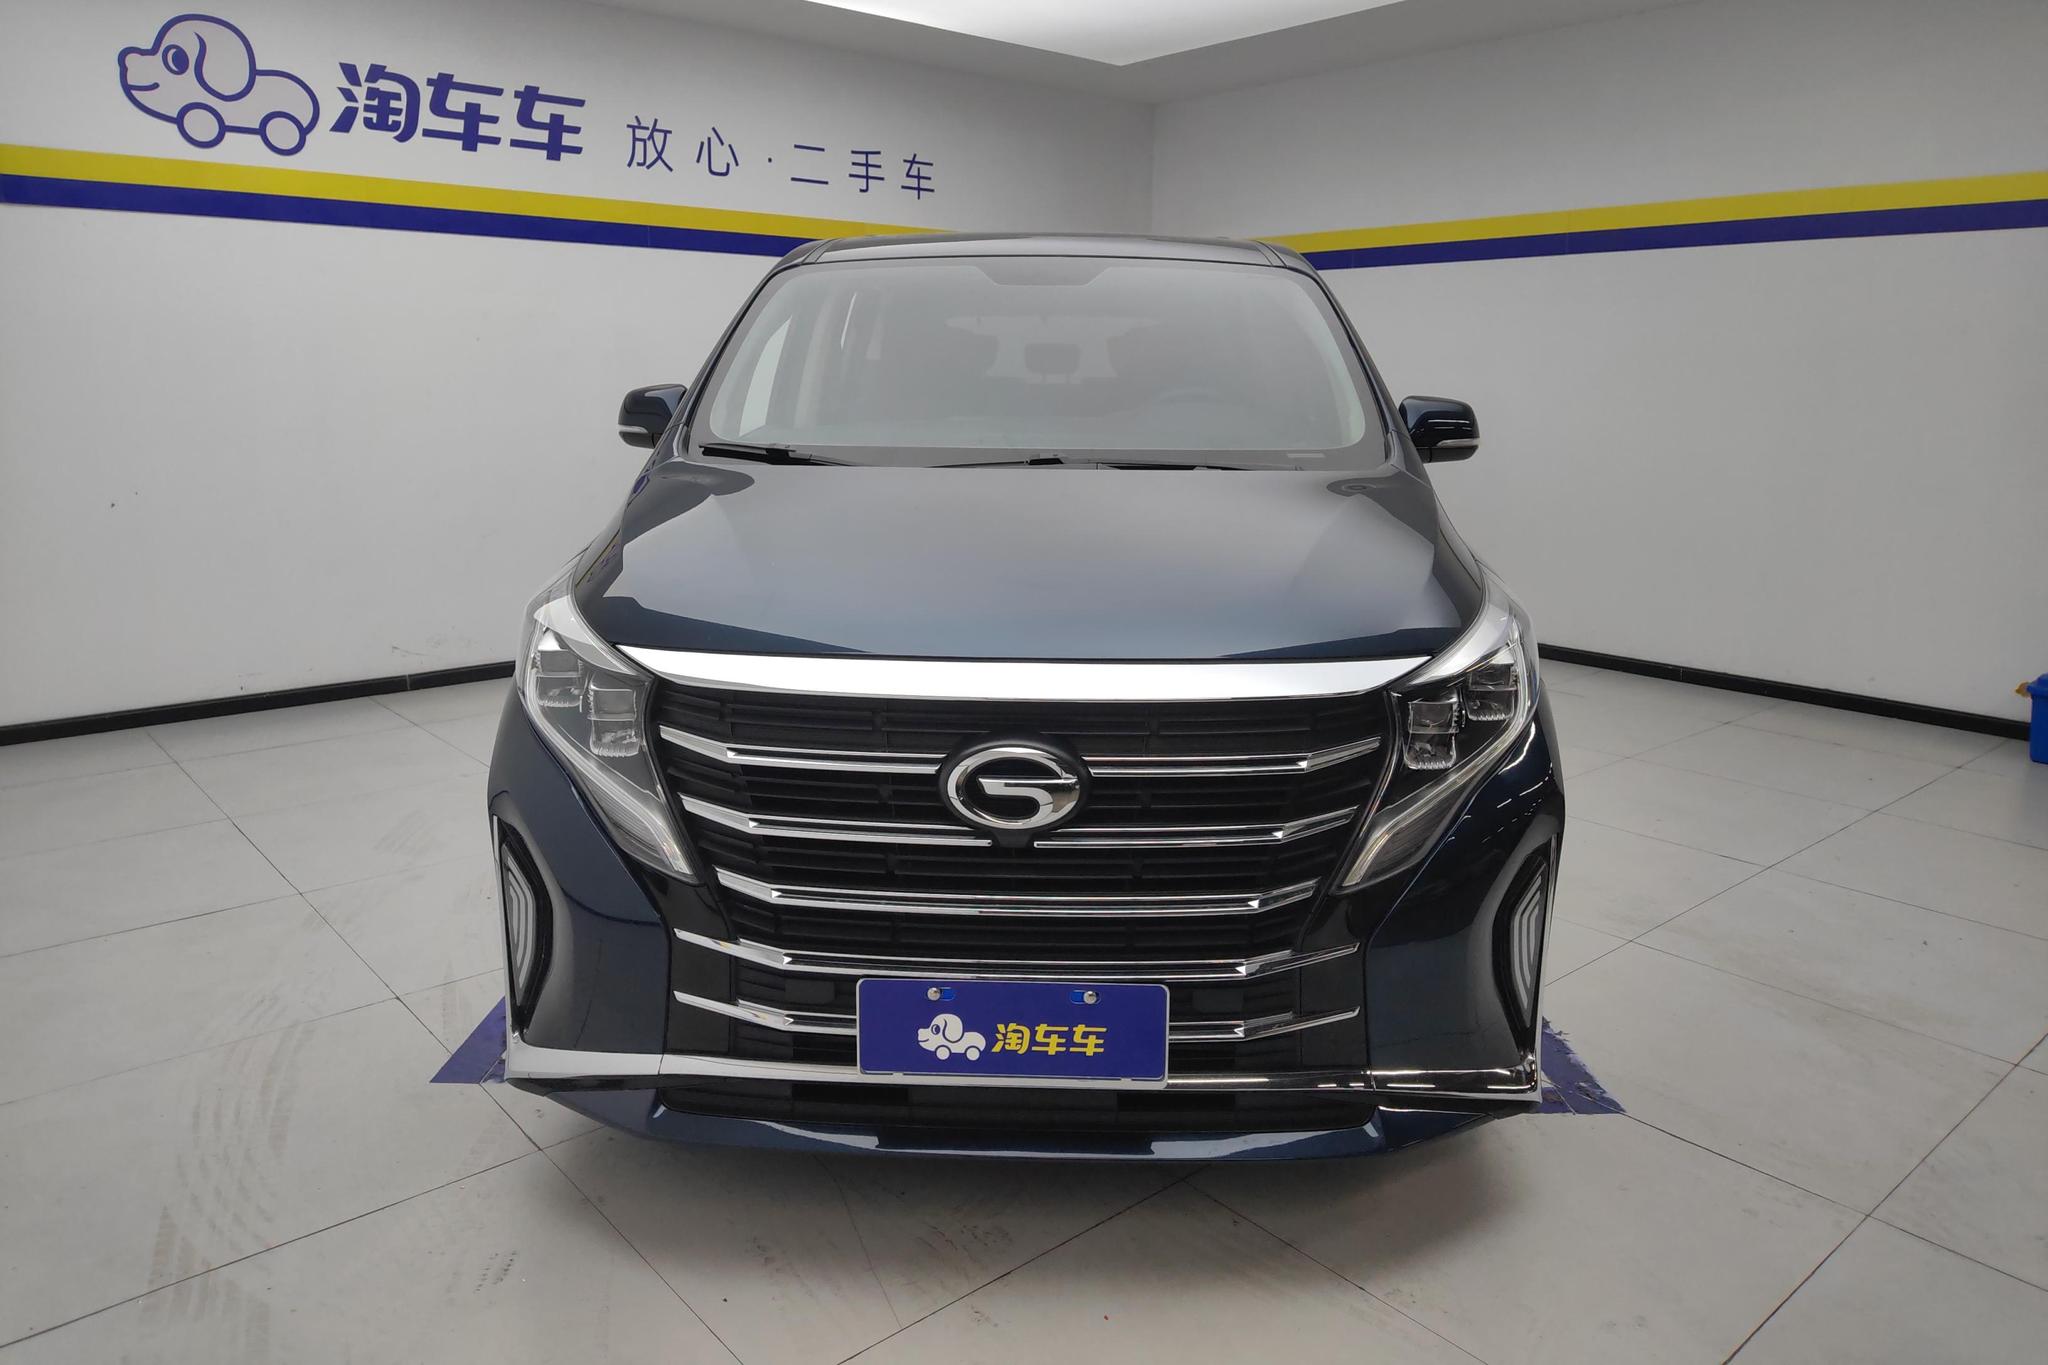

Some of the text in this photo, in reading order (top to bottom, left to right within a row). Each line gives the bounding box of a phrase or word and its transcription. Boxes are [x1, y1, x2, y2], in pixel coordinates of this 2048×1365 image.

[330, 62, 586, 161] 淘车车
[991, 1023, 1107, 1056] 淘车车
